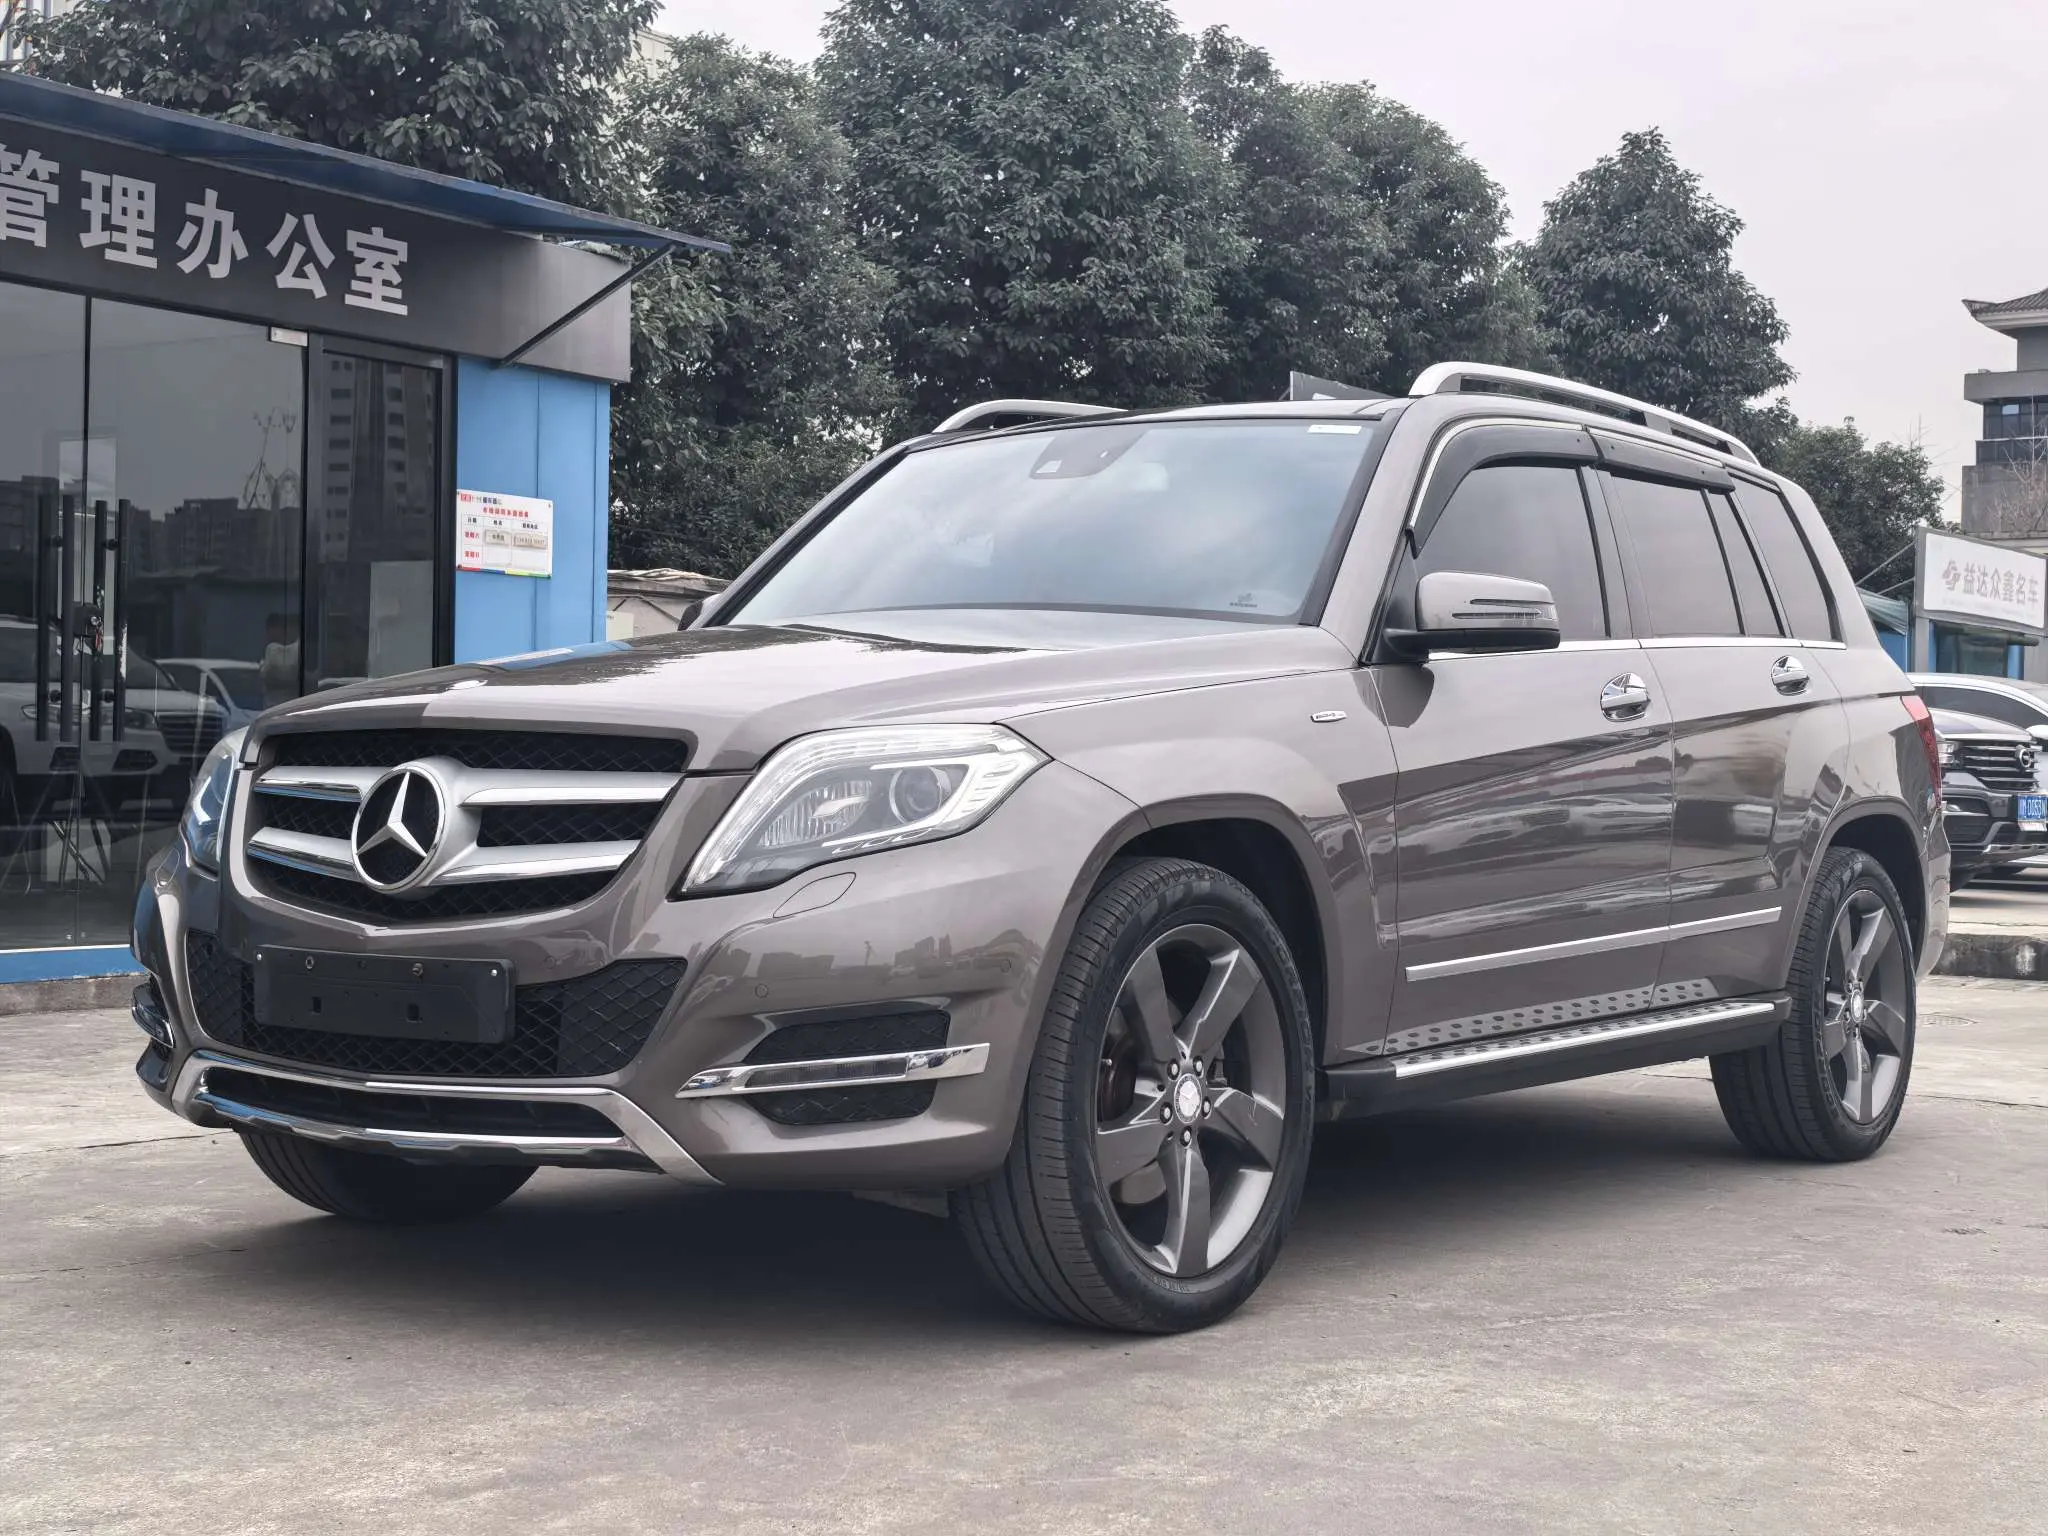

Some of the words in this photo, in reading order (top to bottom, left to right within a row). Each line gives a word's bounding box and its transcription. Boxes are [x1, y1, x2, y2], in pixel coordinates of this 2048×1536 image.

[0, 143, 408, 316] 管理办公室
